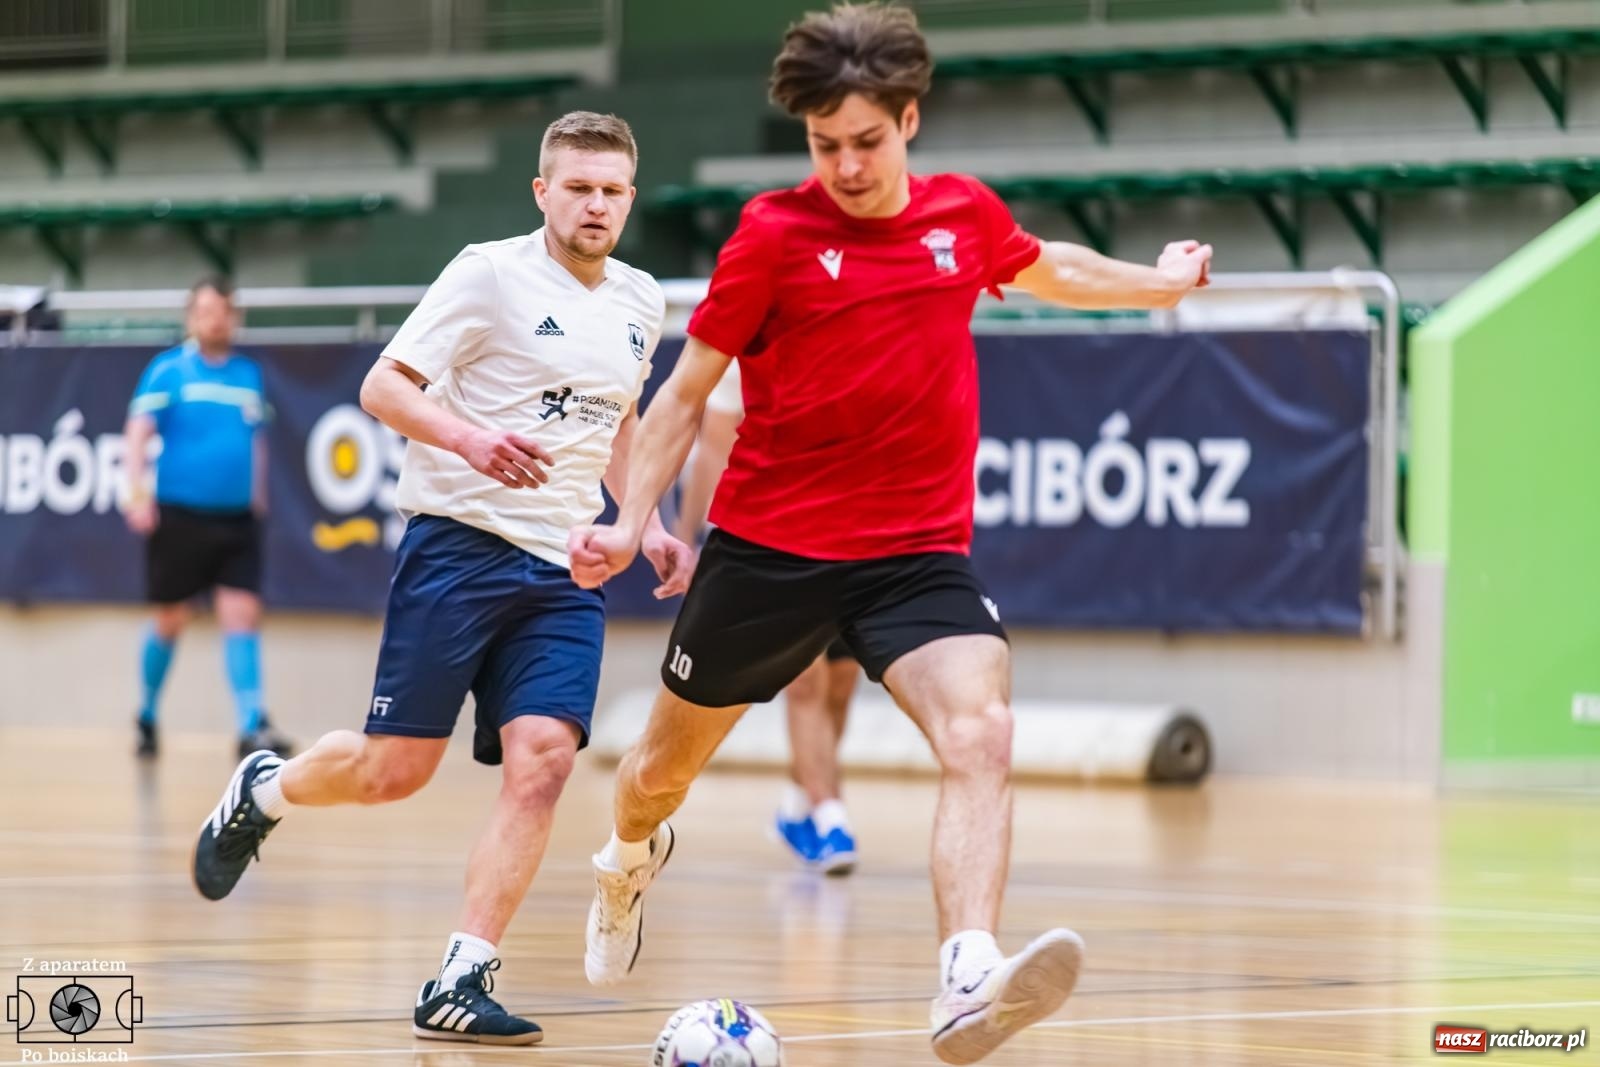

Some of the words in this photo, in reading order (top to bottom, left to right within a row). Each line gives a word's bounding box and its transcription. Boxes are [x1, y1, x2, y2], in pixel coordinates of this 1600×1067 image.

[535, 328, 565, 337] adidas
[973, 410, 1251, 528] CIBÓRZ
[669, 645, 693, 681] 10
